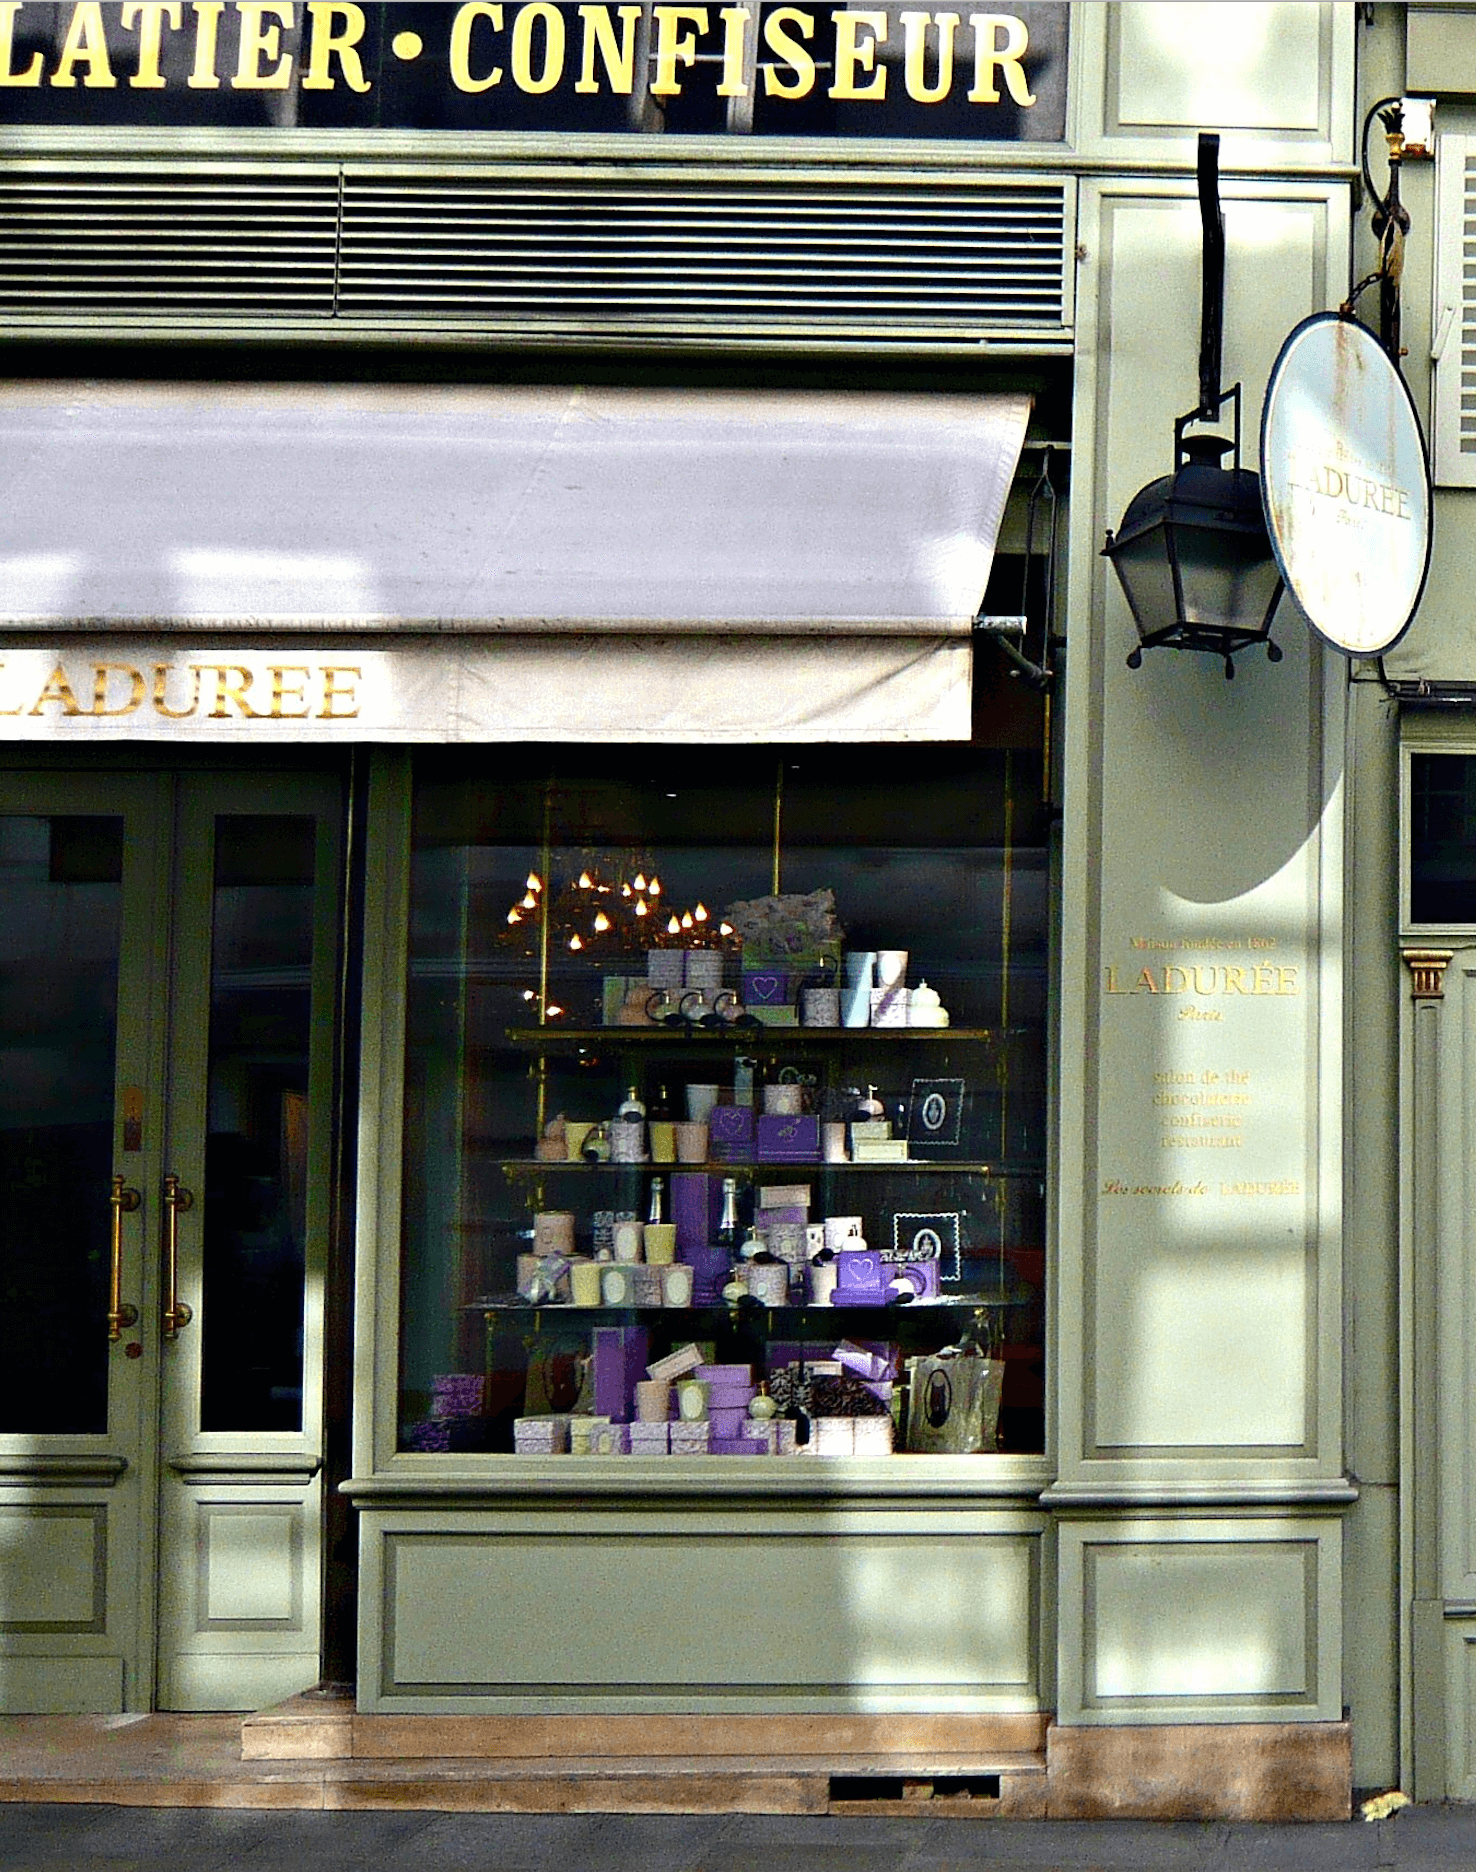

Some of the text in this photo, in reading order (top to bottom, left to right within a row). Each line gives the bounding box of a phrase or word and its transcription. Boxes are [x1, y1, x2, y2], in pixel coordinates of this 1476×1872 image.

[0, 2, 1037, 108] LATIER CONFISEUR
[1103, 959, 1302, 996] LADURÉE
